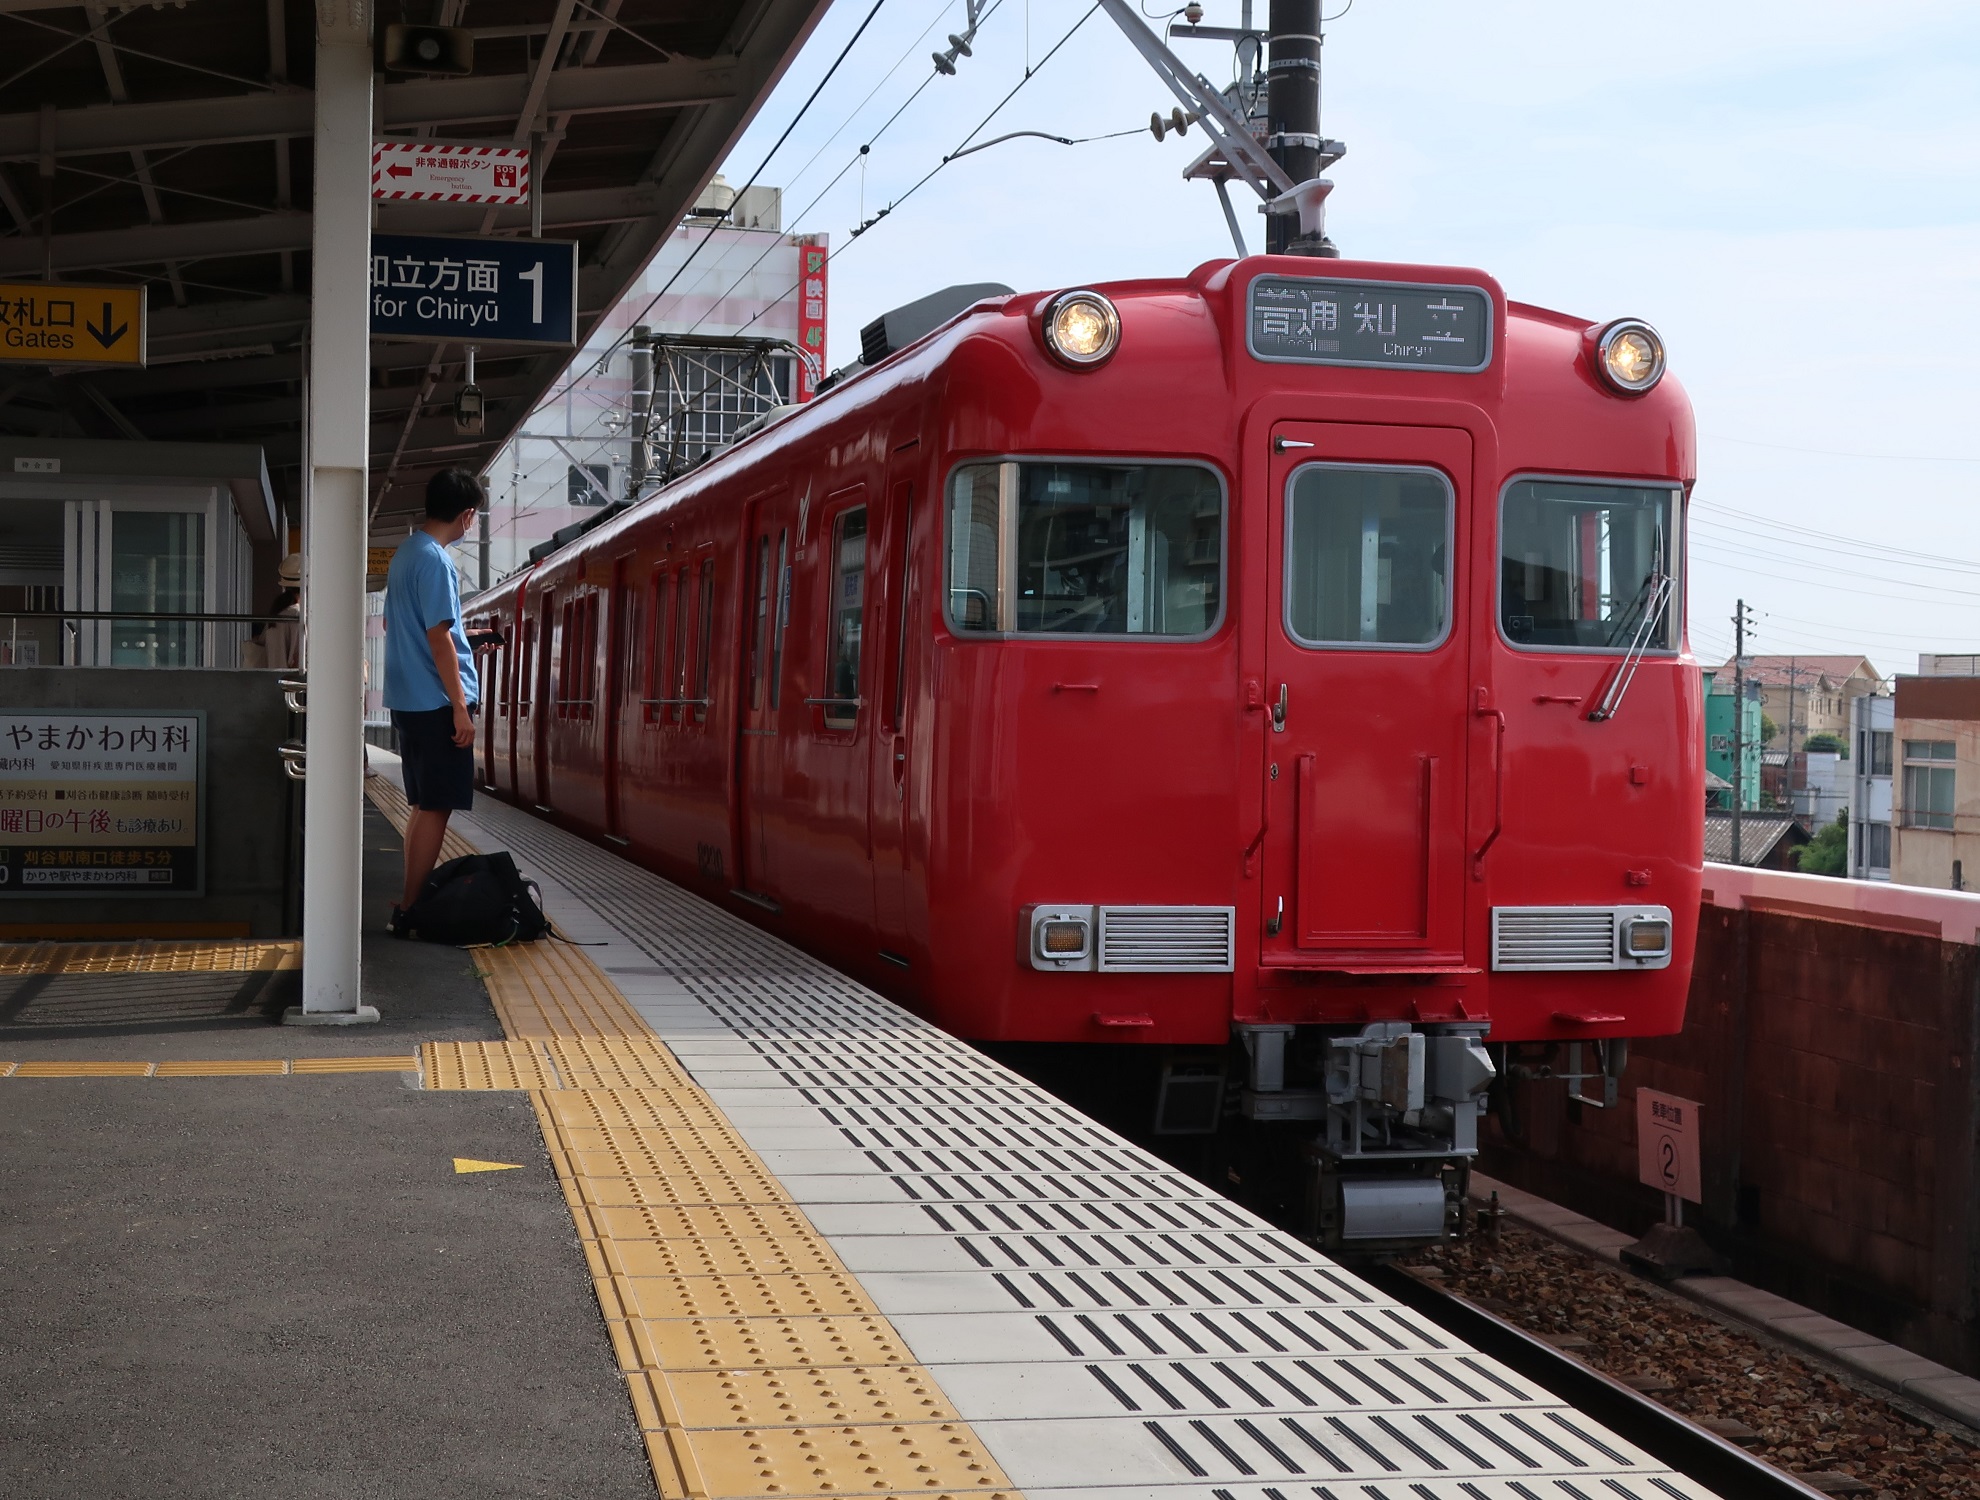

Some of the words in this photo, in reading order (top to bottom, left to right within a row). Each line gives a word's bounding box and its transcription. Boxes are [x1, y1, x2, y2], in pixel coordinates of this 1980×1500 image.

[415, 156, 491, 170] 非常通報ボタン
[496, 165, 515, 173] SOS
[429, 174, 465, 183] Emergency
[451, 182, 473, 190] button
[518, 261, 543, 324] 1
[373, 294, 408, 317] for
[416, 295, 499, 327] Chiryū
[5, 327, 74, 349] Gates
[6, 724, 191, 752] やまかわ内科
[23, 850, 173, 865] 刈谷駅南口徒歩5分
[25, 870, 138, 882] かりや駅やまかわ内科
[1663, 1143, 1675, 1179] 2
